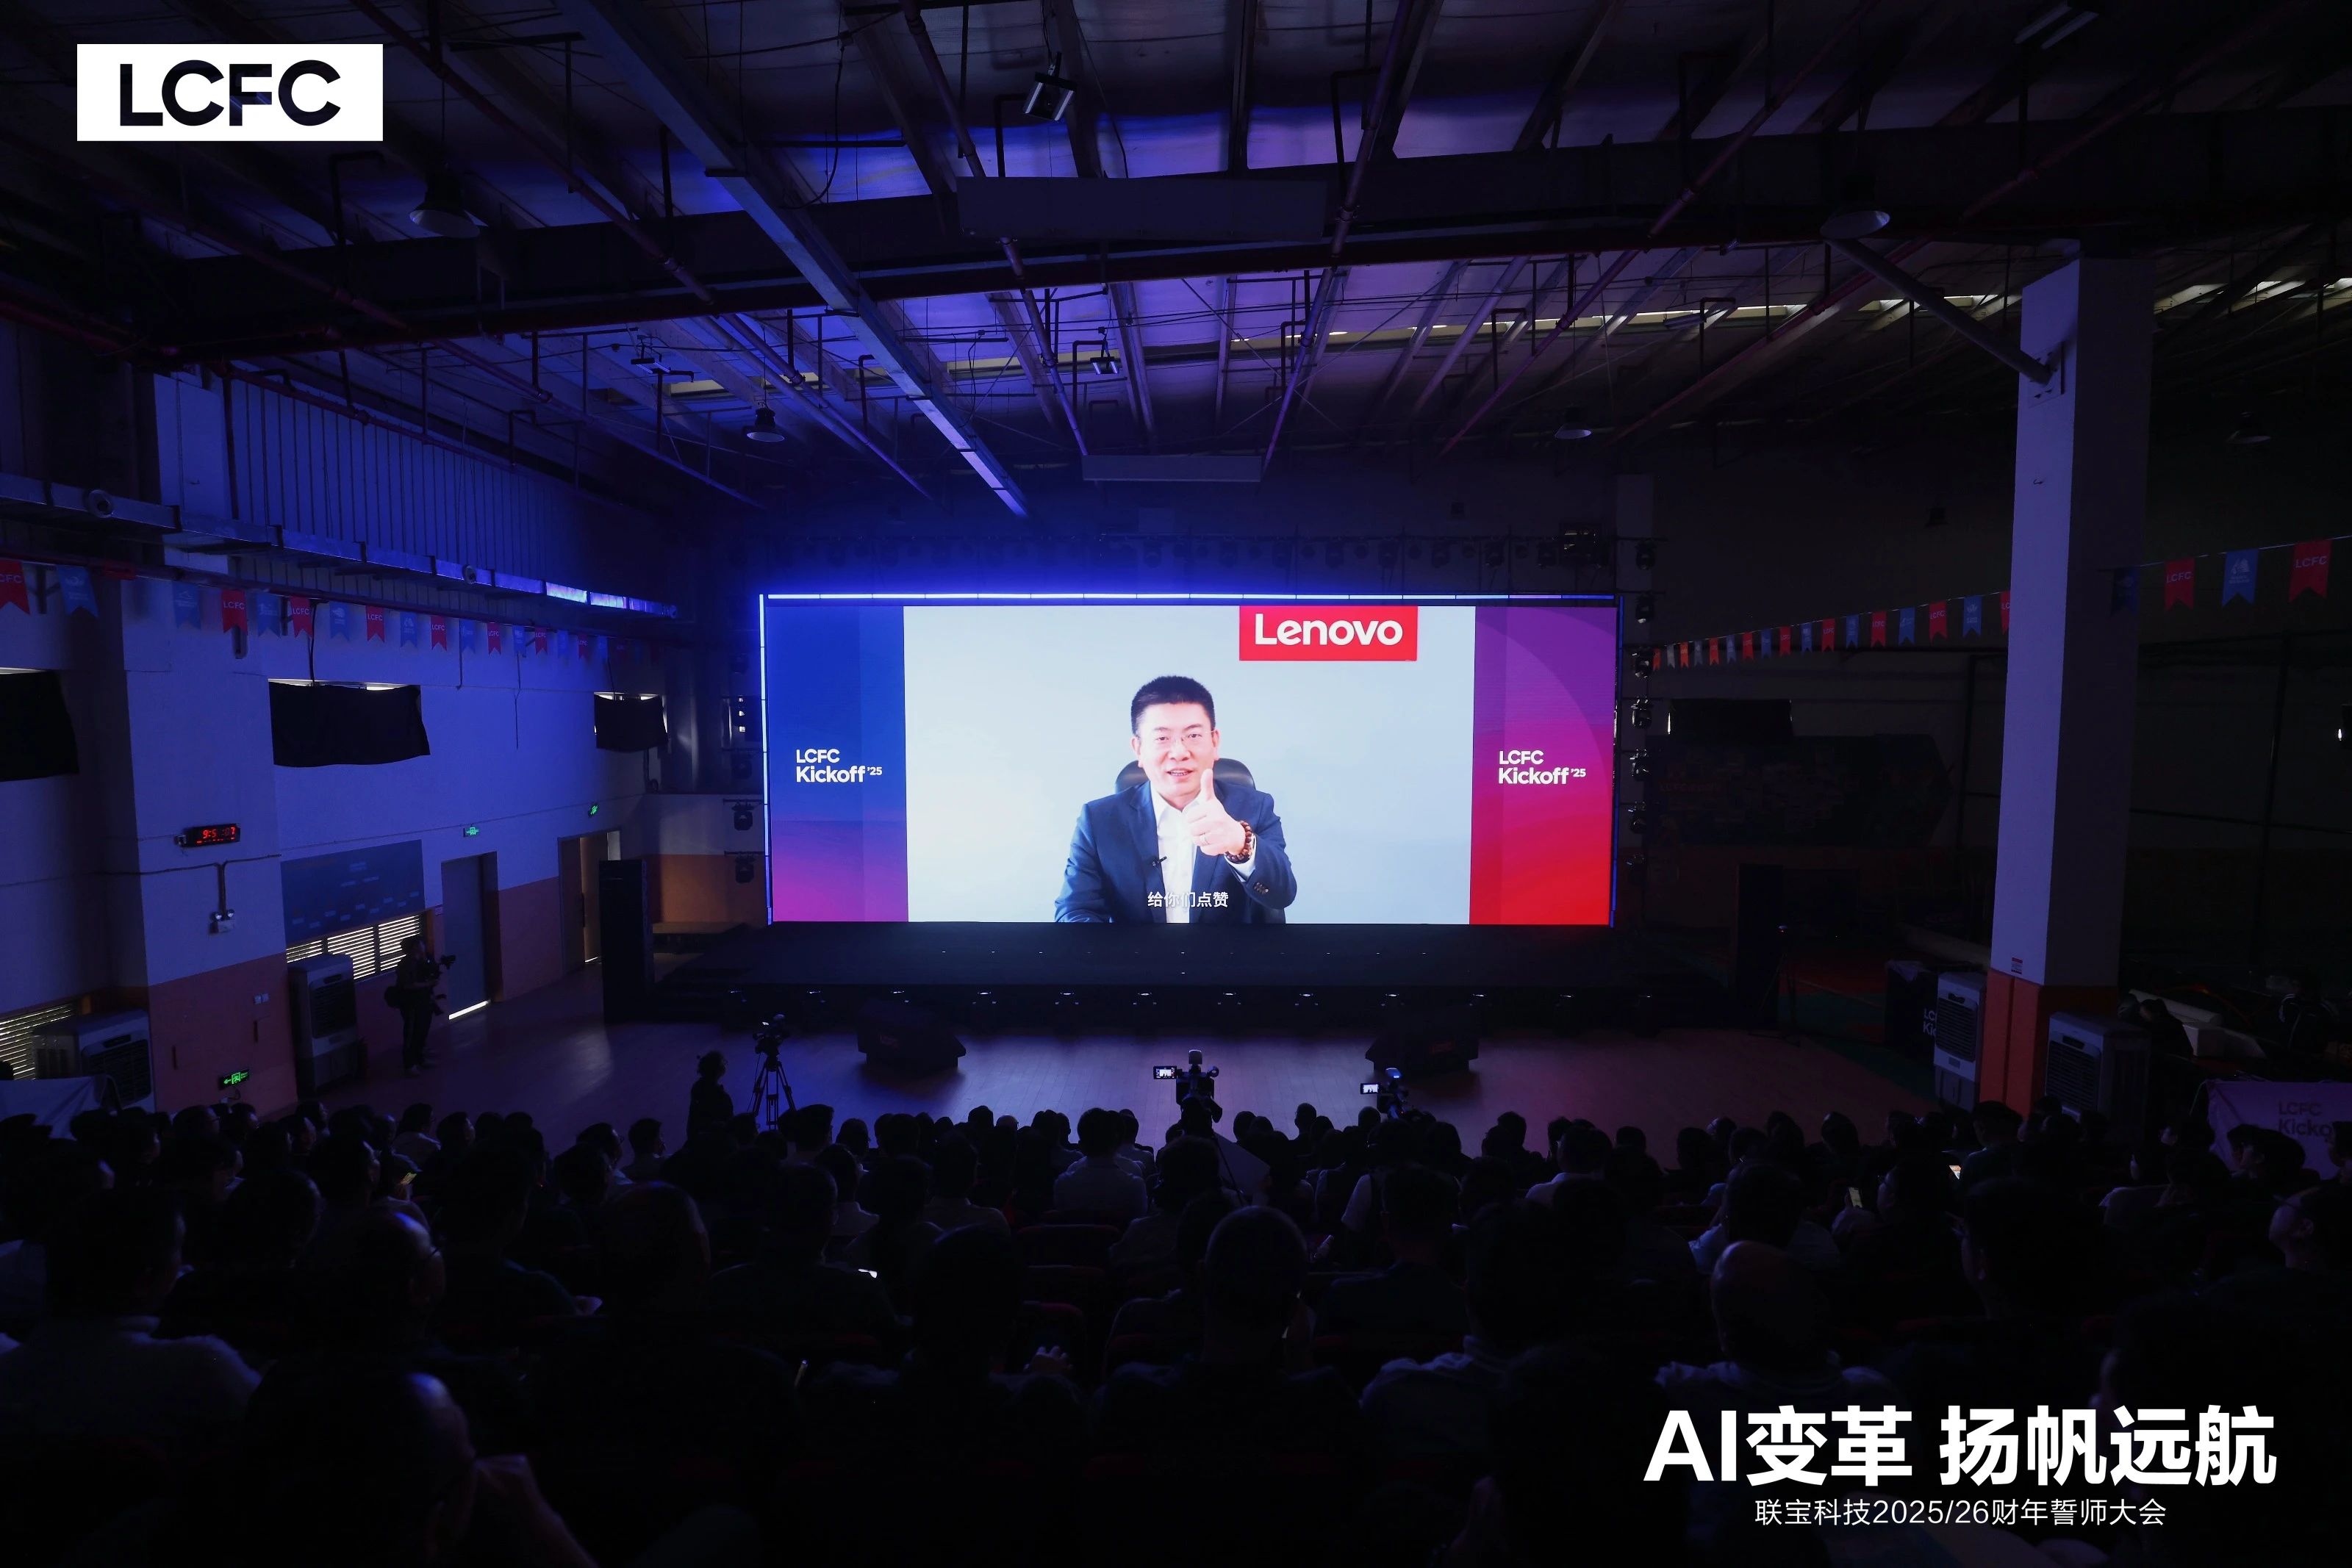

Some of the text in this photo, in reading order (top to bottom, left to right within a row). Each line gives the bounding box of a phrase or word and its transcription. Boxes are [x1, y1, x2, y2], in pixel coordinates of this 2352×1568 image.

[2295, 555, 2328, 569] LCFC
[2167, 571, 2194, 583] LCFC
[223, 601, 245, 610] LCFC
[1255, 614, 1402, 645] Lenovo
[796, 748, 840, 763] LCFC
[1499, 749, 1544, 765] LCFC
[796, 765, 866, 783] Kickoff
[1498, 766, 1569, 785] Kickoff
[1147, 891, 1230, 908] 给你们点赞
[2279, 1101, 2323, 1115] LCFC
[2279, 1119, 2333, 1136] Kicko
